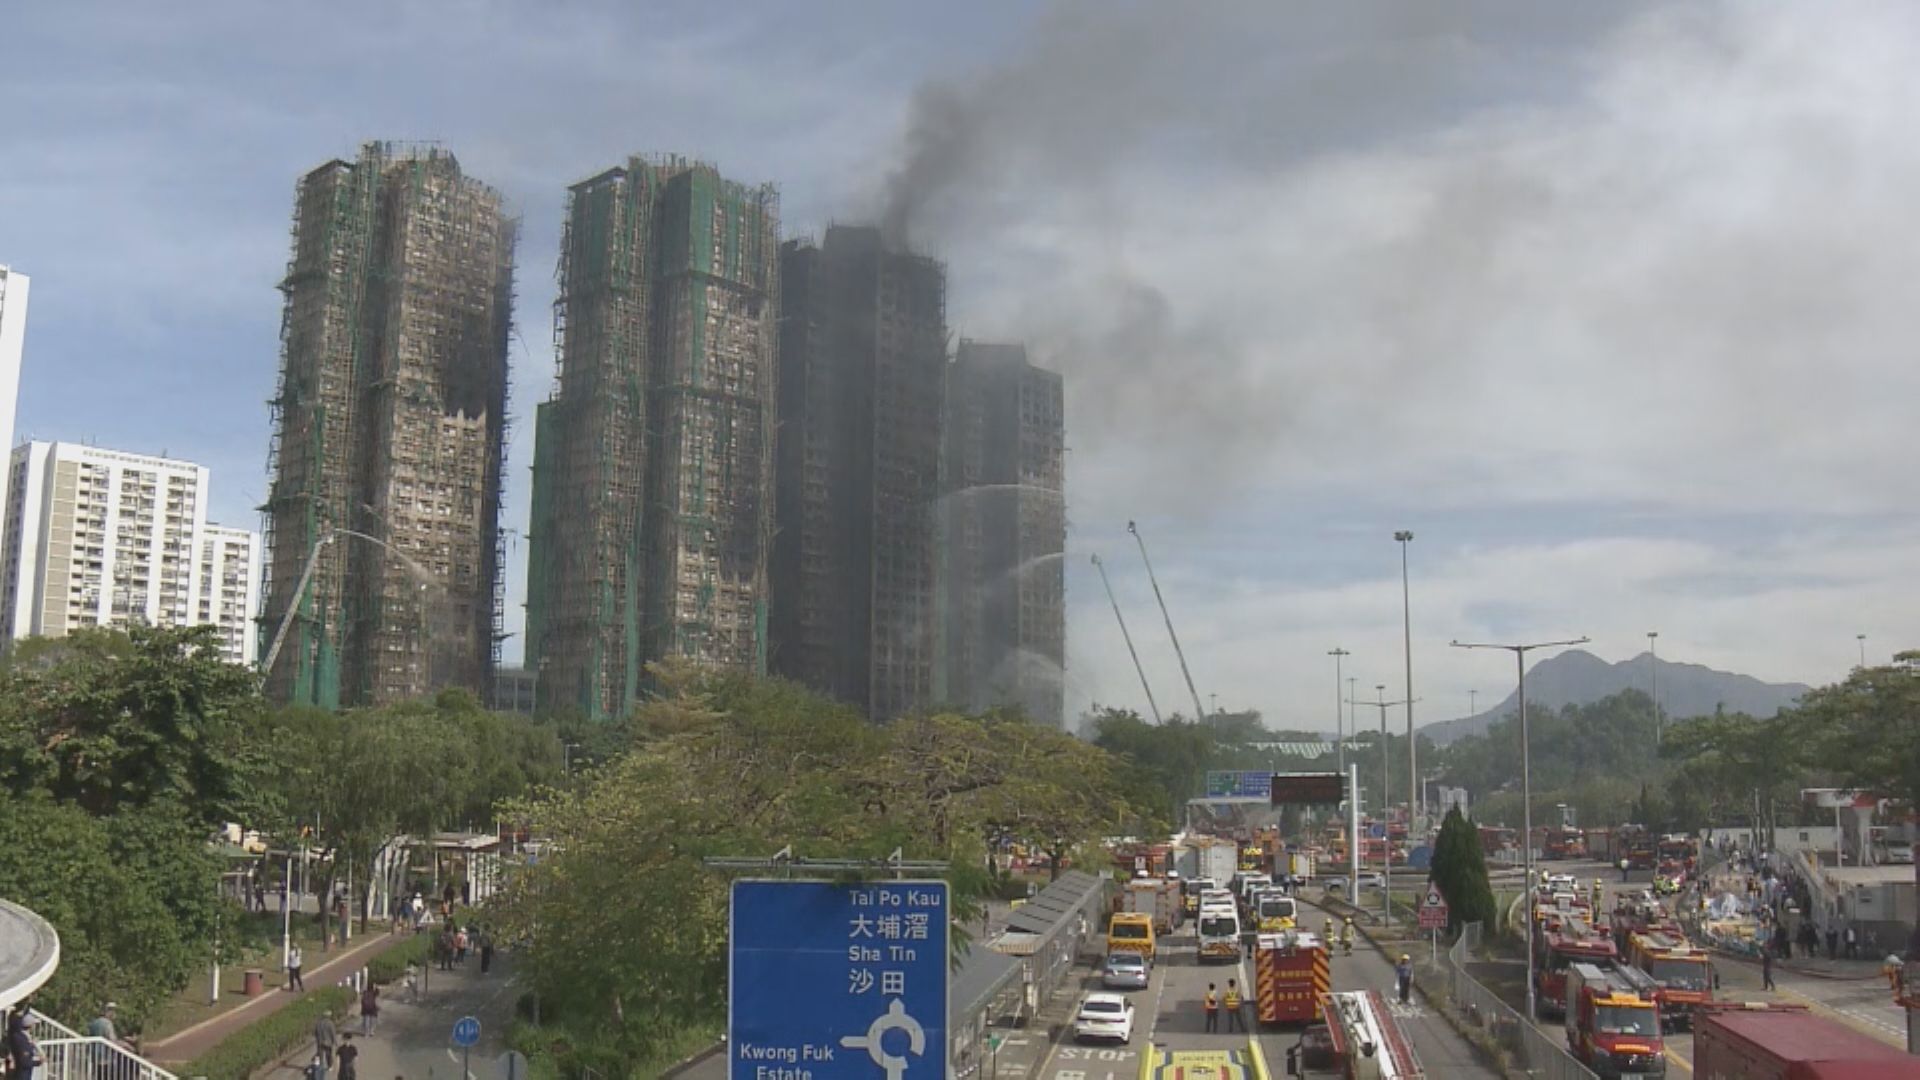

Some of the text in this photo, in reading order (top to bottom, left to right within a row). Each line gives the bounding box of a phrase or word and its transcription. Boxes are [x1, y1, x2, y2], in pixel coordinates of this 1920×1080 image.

[849, 890, 940, 906] Tai Po Kau
[849, 913, 928, 939] 大埔滘
[849, 945, 916, 961] Sha Tin
[849, 968, 904, 995] 沙田
[740, 1043, 834, 1063] Kwong Fuk
[1058, 1048, 1136, 1061] STOP
[757, 1066, 812, 1080] Estate
